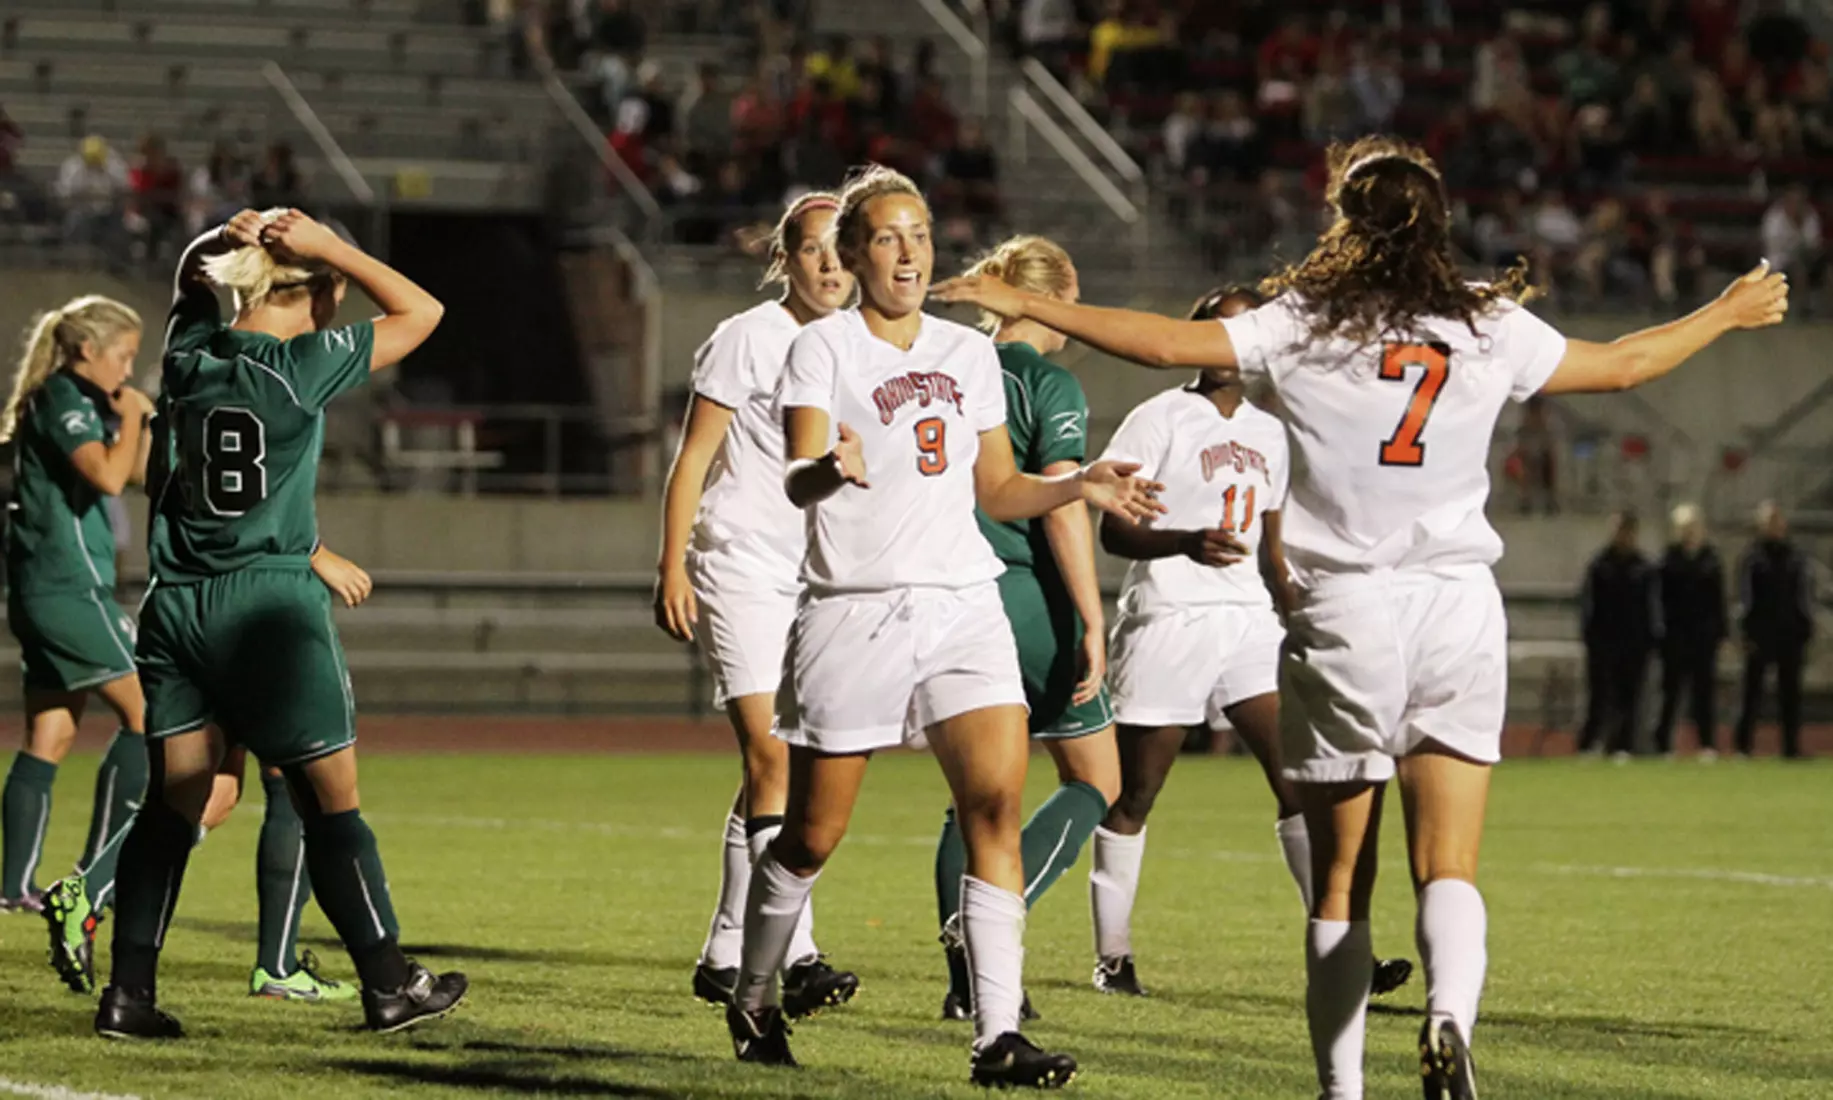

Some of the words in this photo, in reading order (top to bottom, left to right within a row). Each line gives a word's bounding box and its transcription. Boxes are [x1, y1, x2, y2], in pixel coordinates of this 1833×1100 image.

[1378, 340, 1451, 466] 7
[913, 416, 948, 477] 9
[1219, 484, 1255, 533] 11
